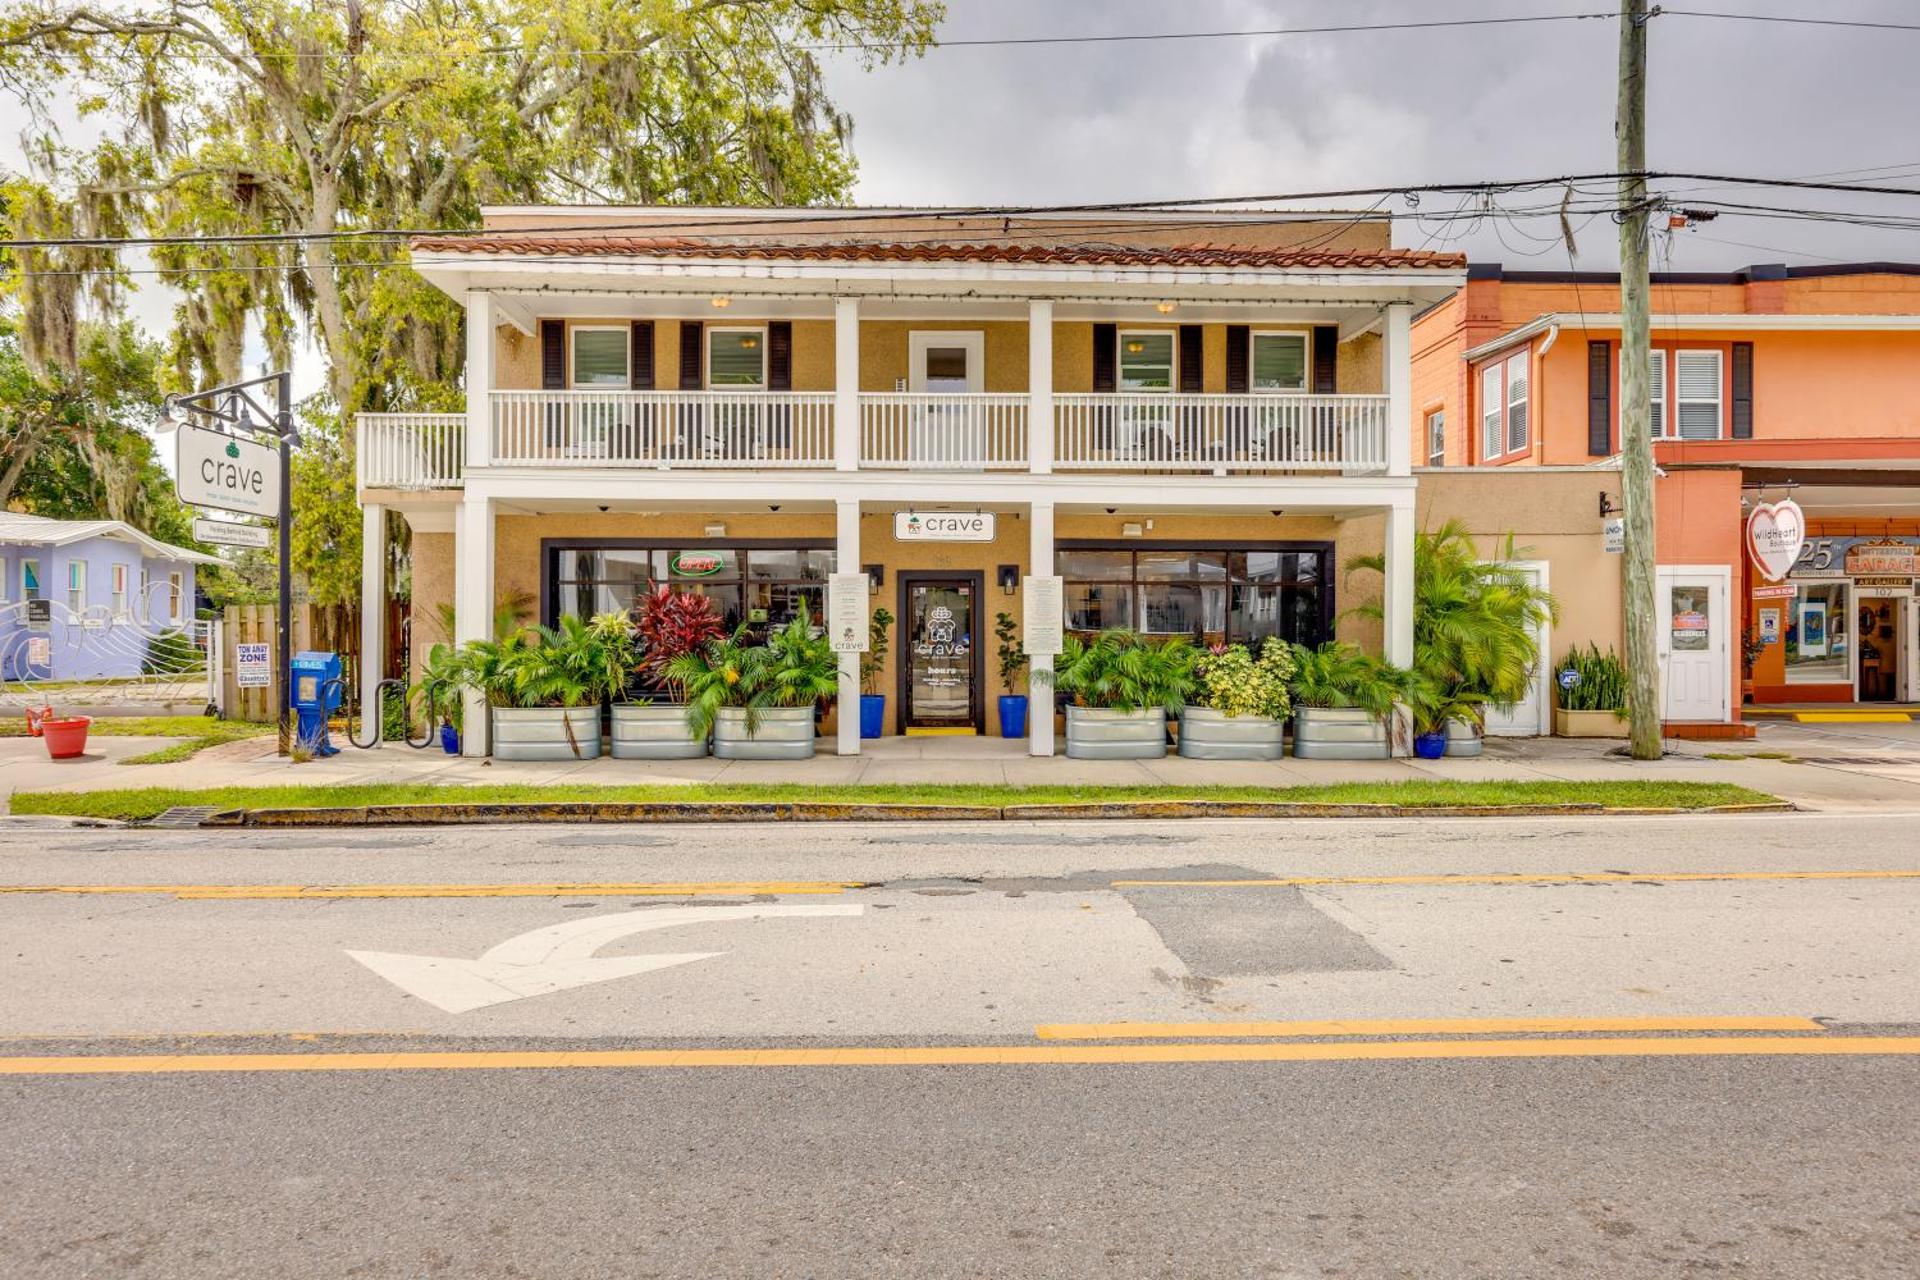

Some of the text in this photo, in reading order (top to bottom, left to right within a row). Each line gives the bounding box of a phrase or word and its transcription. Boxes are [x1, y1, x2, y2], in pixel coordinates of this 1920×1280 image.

[201, 458, 263, 494] crave
[926, 518, 983, 531] crave
[1754, 528, 1796, 540] WildHeart
[238, 645, 268, 654] TOW AWAY
[835, 642, 864, 650] crave
[919, 645, 965, 655] crave
[240, 654, 267, 662] ZONE
